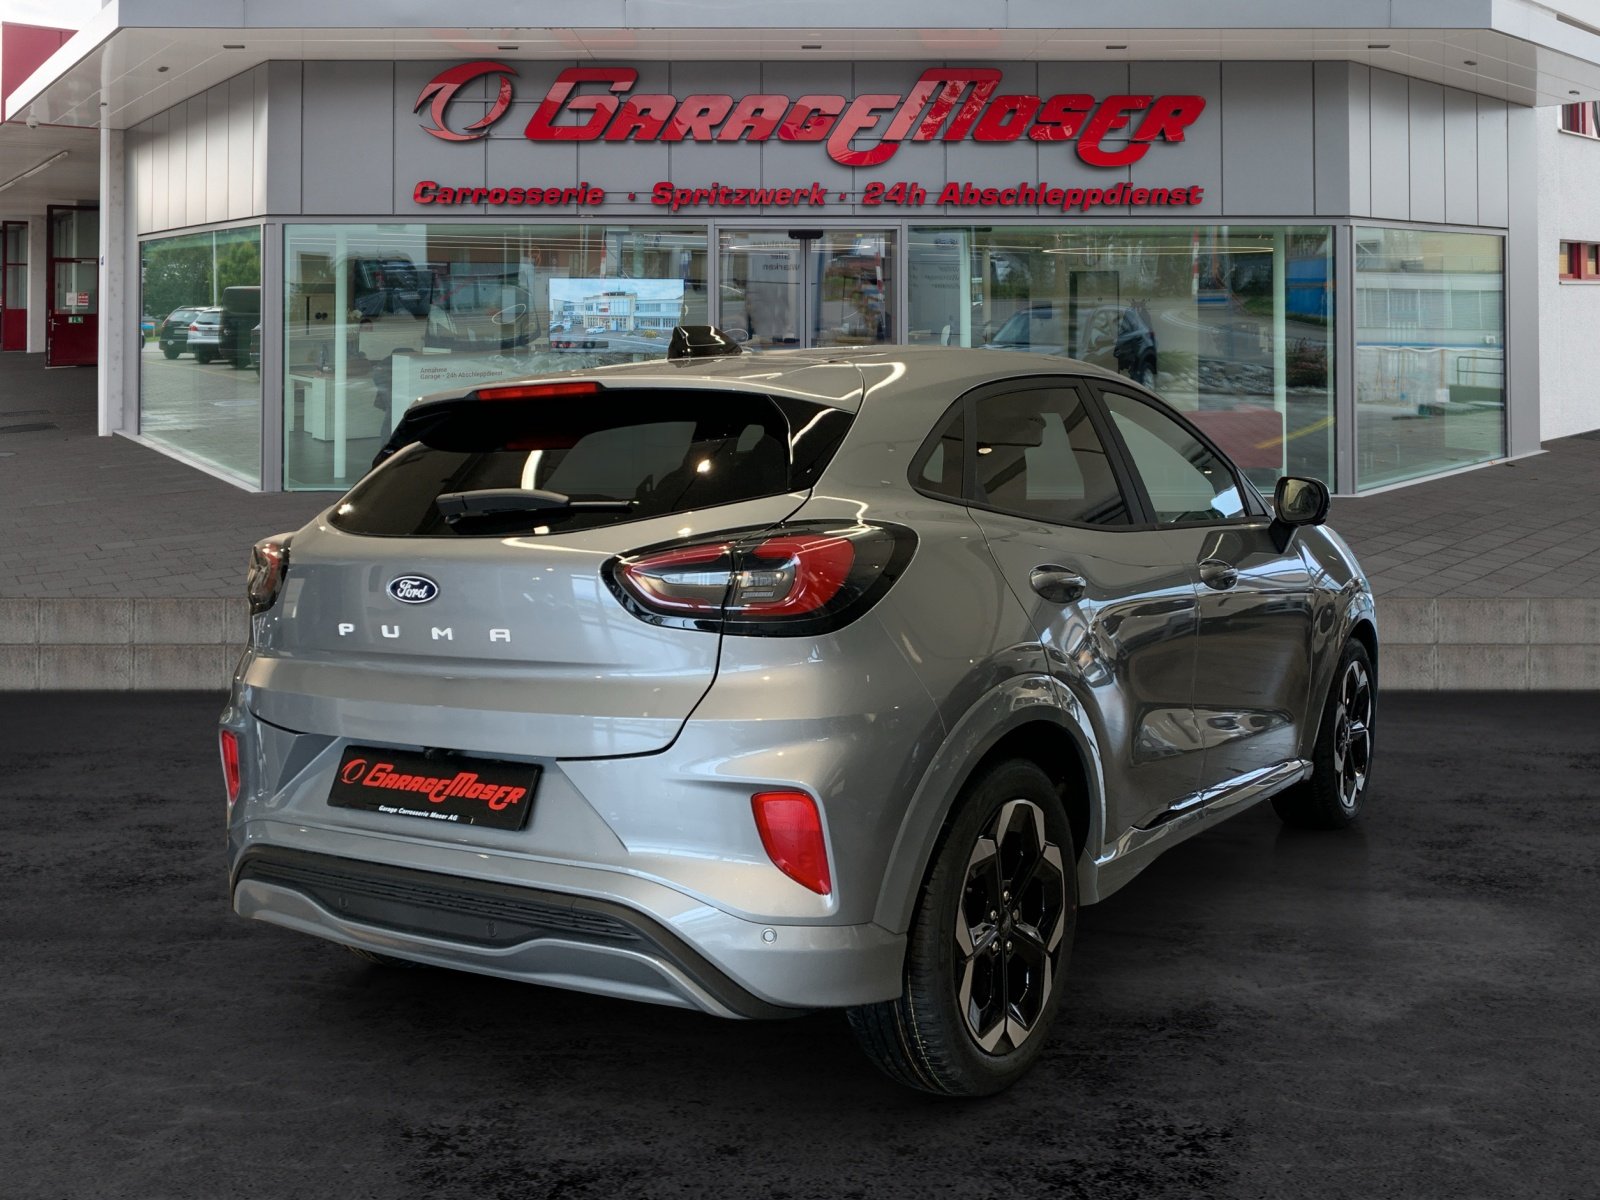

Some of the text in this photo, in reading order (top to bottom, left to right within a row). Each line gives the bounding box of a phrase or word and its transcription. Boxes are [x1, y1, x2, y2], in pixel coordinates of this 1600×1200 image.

[412, 180, 1204, 212] Carrosserie Spritzwerk 24h Abschleppdienst
[397, 579, 428, 599] Ford
[338, 623, 511, 642] PUMA
[378, 805, 398, 814] Garage
[398, 808, 429, 817] Carrosserie
[429, 811, 449, 819] Moser
